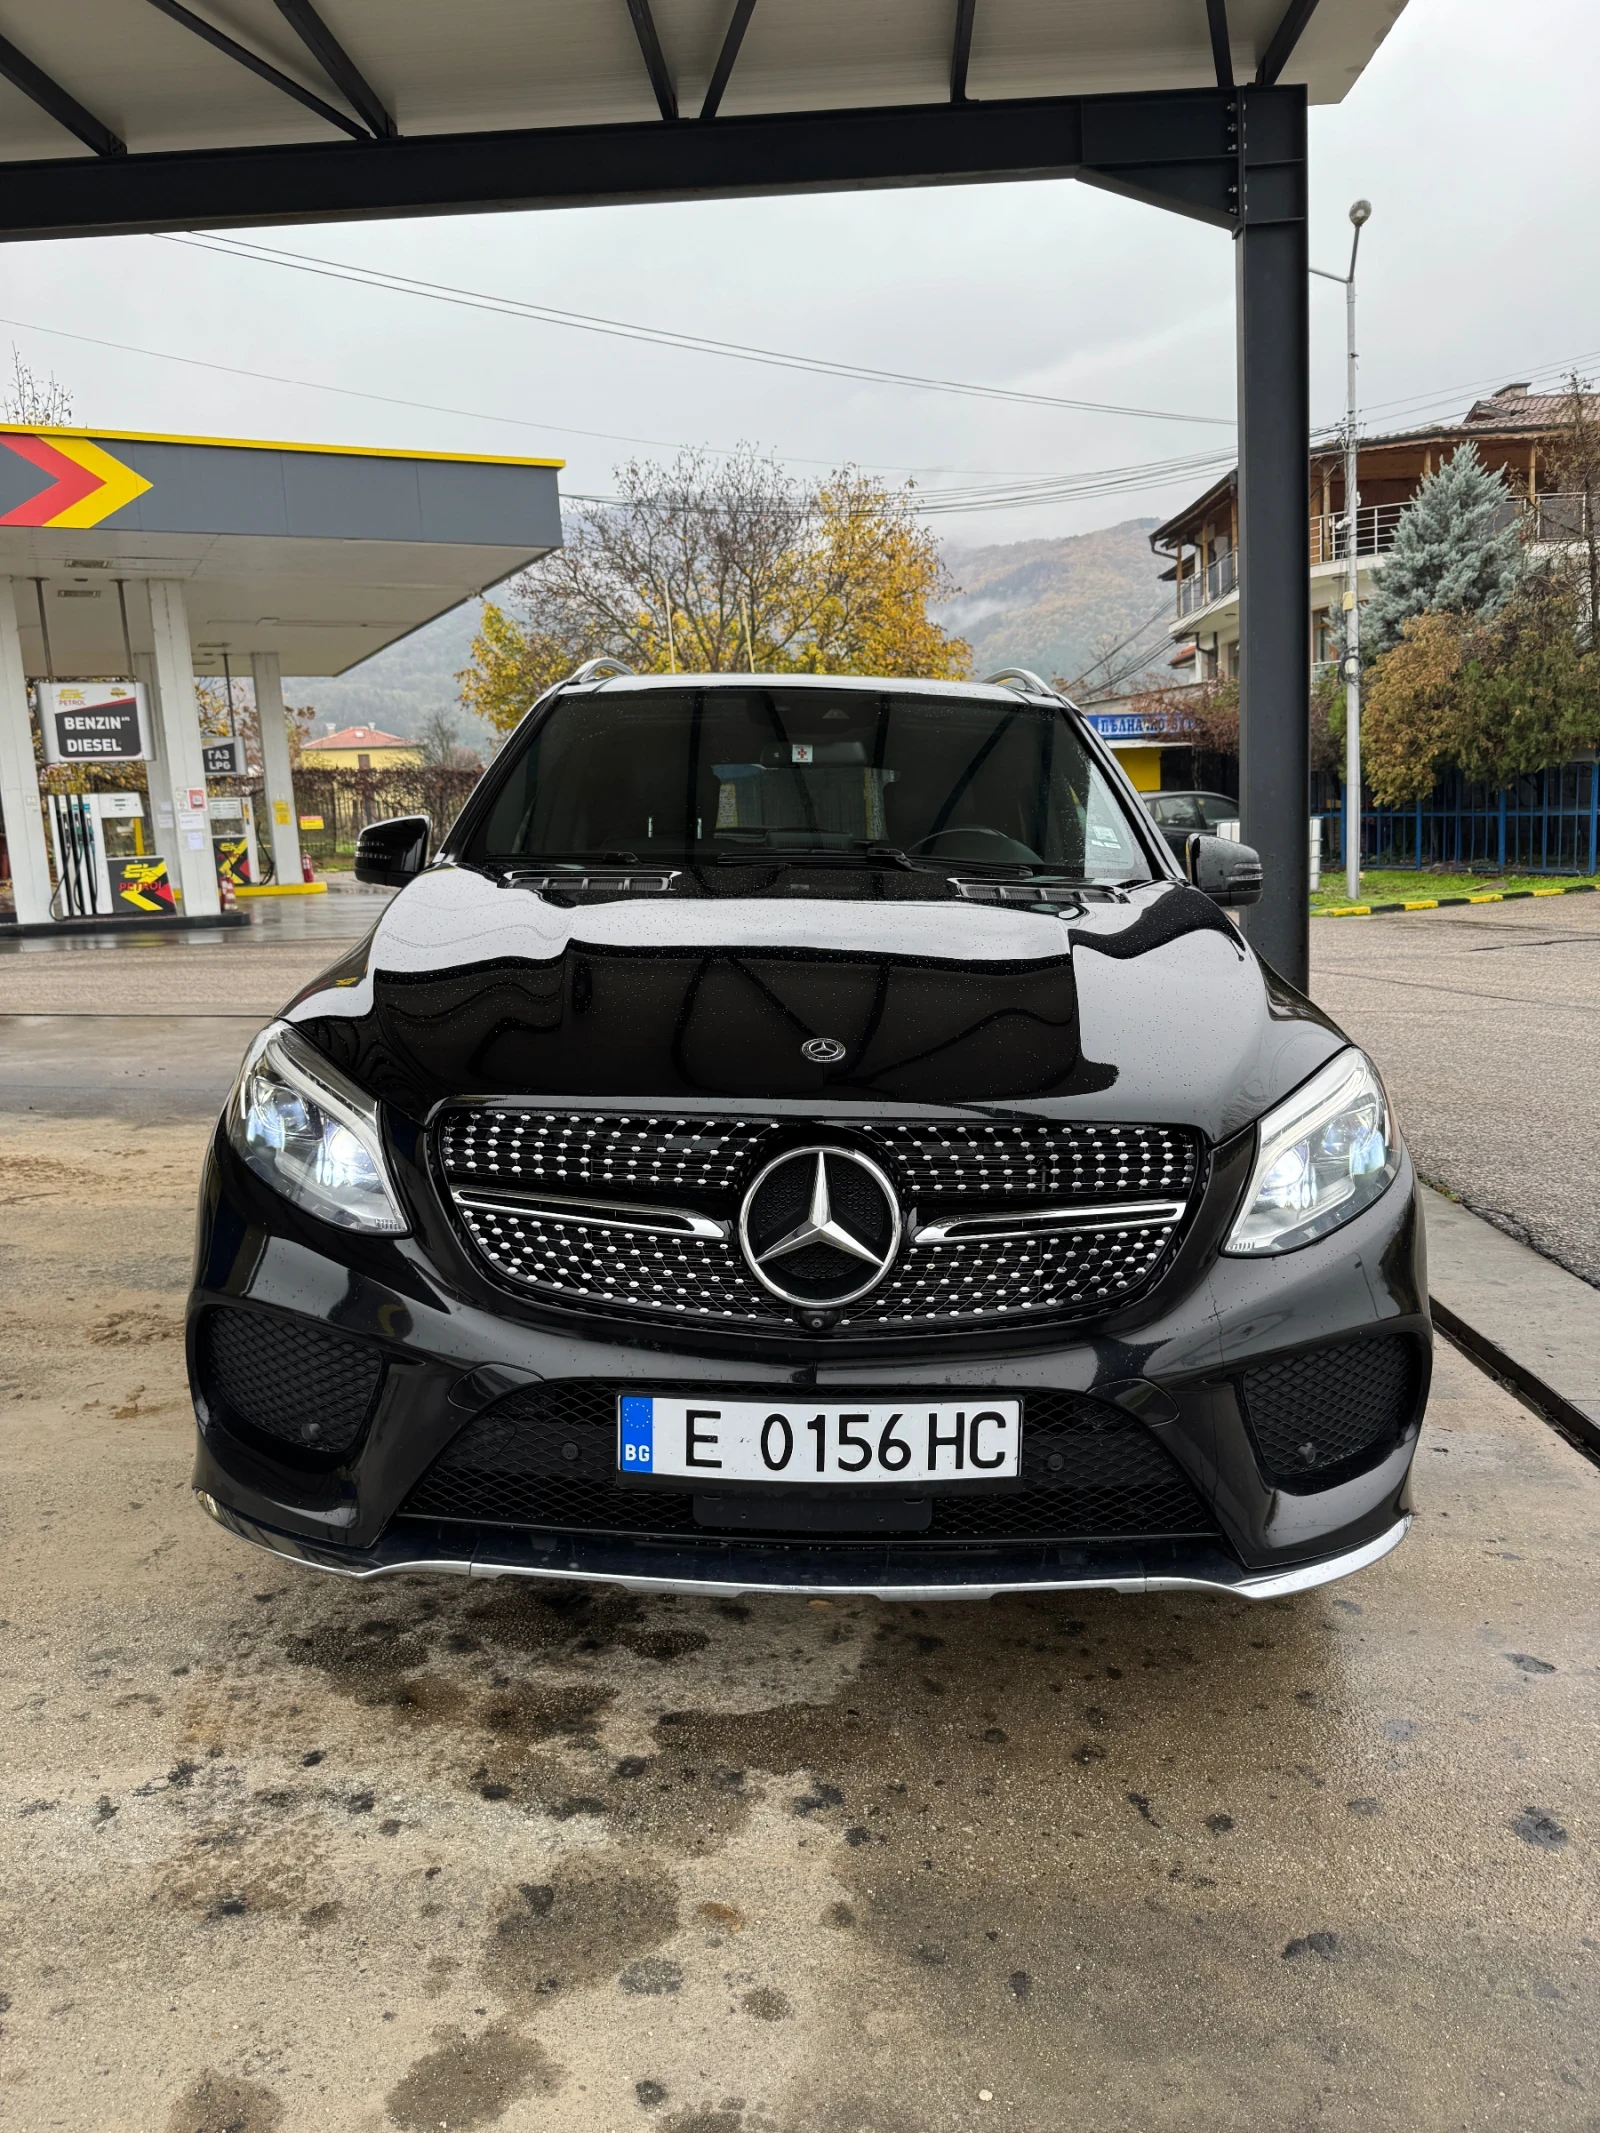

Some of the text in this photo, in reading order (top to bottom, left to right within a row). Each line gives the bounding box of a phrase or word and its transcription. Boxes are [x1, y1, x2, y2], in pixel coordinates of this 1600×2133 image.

[64, 716, 122, 730] BENZIN
[66, 738, 123, 752] DIESEL
[207, 749, 230, 760] ГАЗ
[208, 760, 231, 770] LPG
[118, 881, 164, 892] PETROL
[686, 1409, 1007, 1473] E 0156 HC
[625, 1445, 651, 1463] BG
